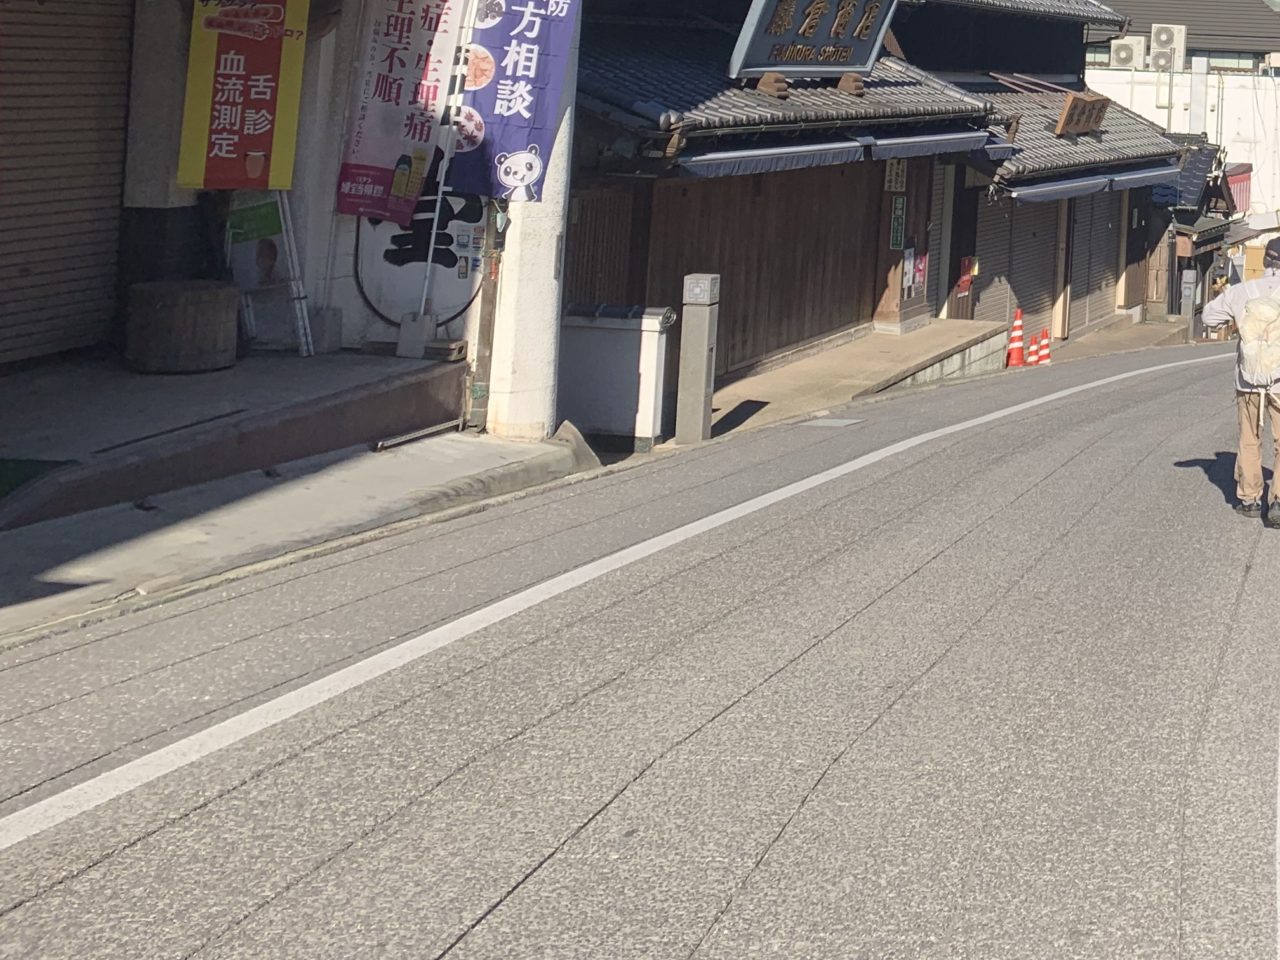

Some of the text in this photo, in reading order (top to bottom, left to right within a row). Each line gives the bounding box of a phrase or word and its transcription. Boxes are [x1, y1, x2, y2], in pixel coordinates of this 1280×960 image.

[209, 50, 247, 159] 血流測定
[243, 74, 276, 136] 舌診
